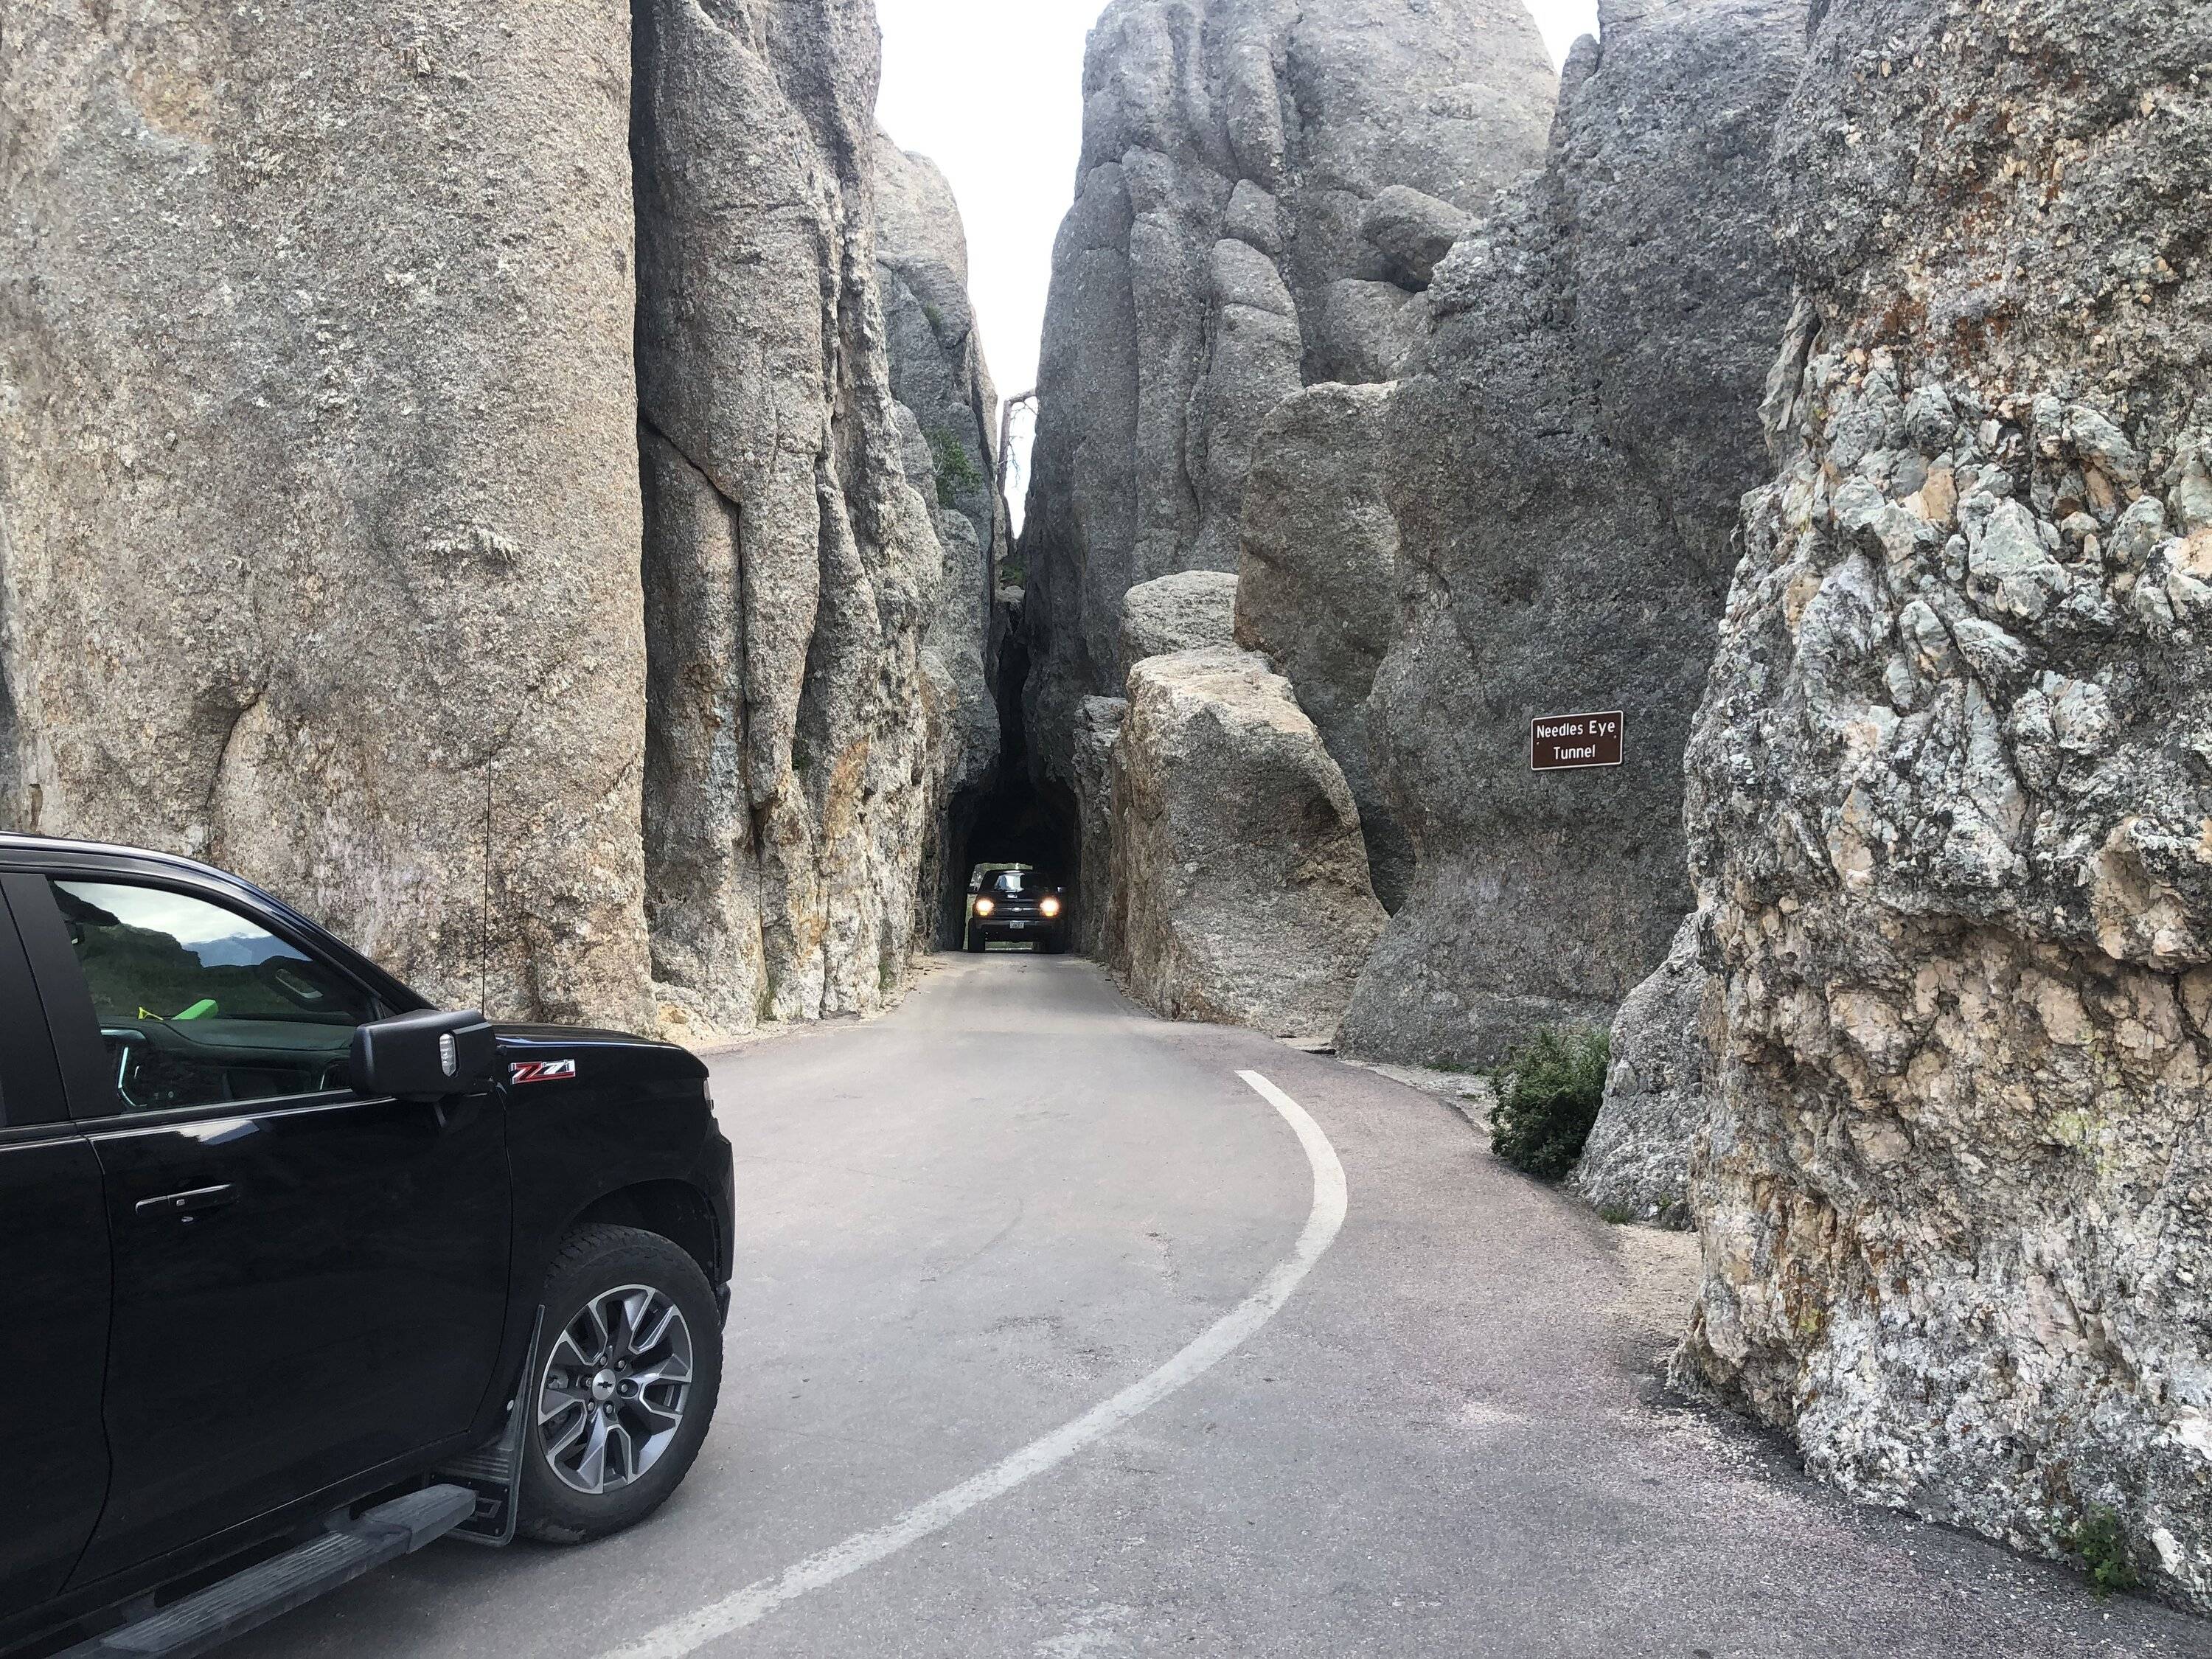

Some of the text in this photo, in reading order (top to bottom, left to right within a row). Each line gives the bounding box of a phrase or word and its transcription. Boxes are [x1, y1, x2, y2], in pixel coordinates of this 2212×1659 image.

[1537, 720, 1615, 738] Needles Eye
[1553, 744, 1596, 760] Tunnel
[509, 1059, 576, 1085] Z71
